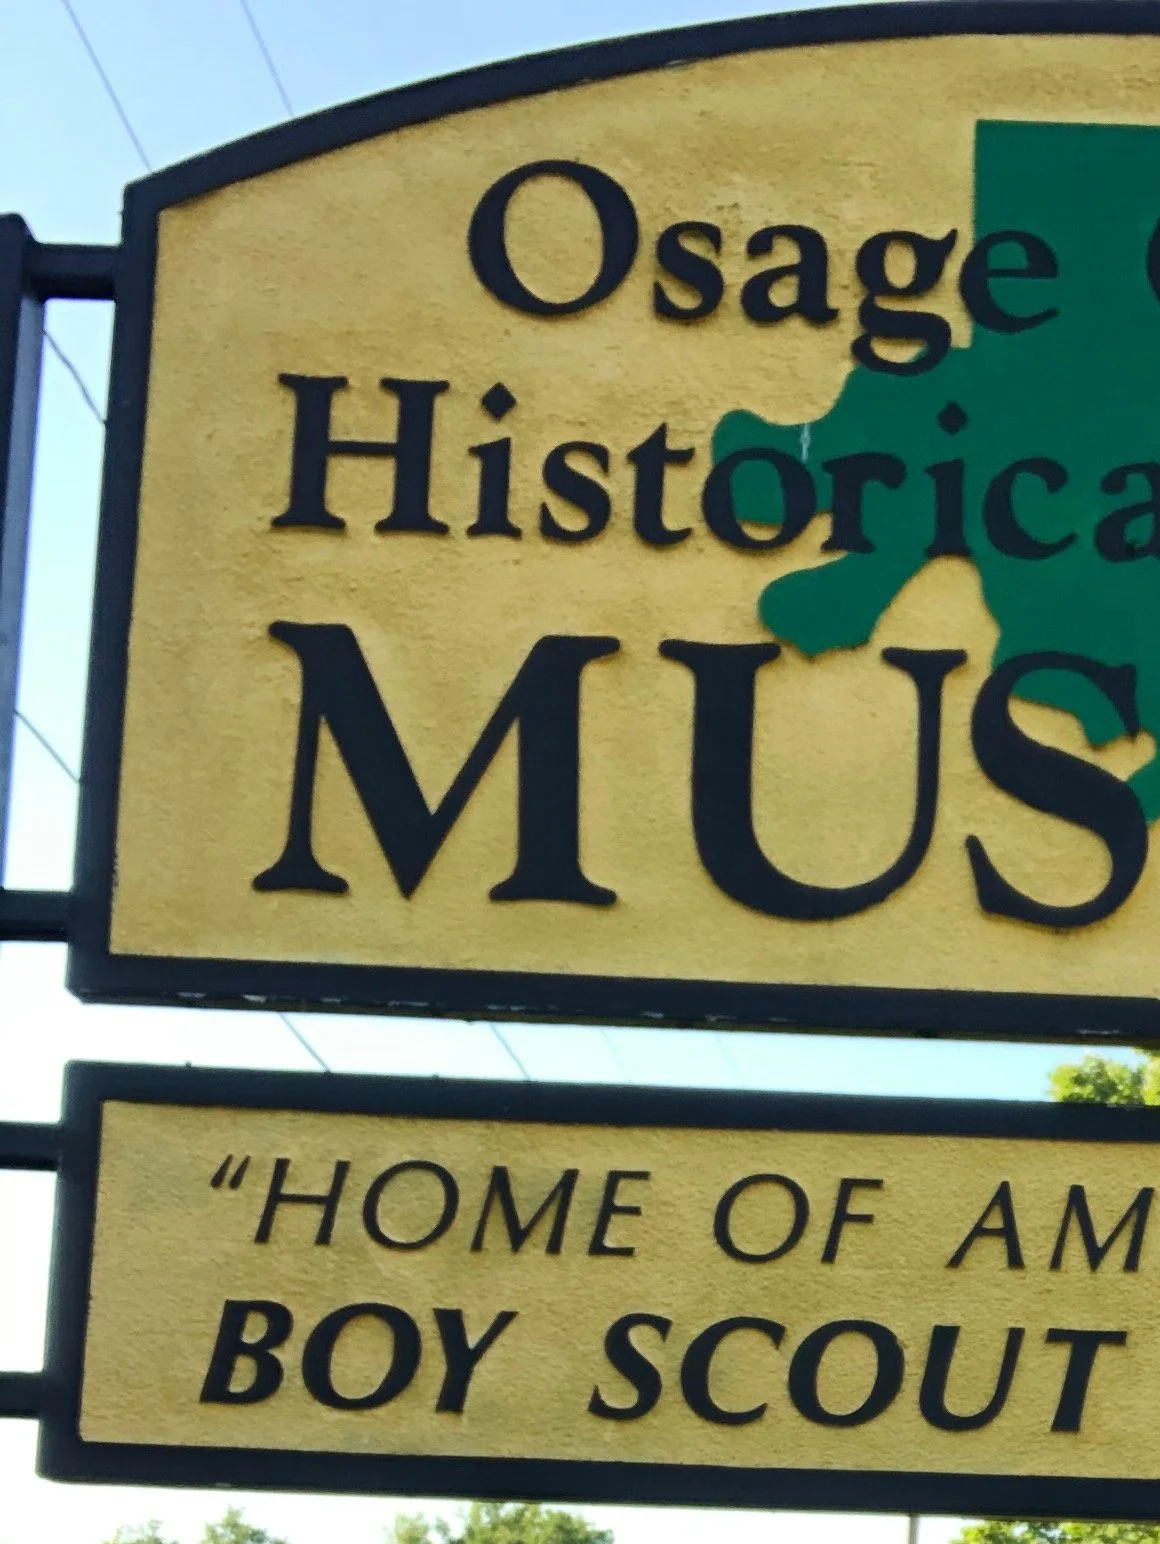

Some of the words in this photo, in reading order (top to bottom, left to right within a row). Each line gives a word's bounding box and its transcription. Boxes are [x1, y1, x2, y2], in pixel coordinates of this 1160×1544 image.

[468, 160, 1060, 376] Osage
[712, 1173, 884, 1264] OF
[199, 1298, 518, 1413] BOY
[587, 1312, 1127, 1432] SCOUT
